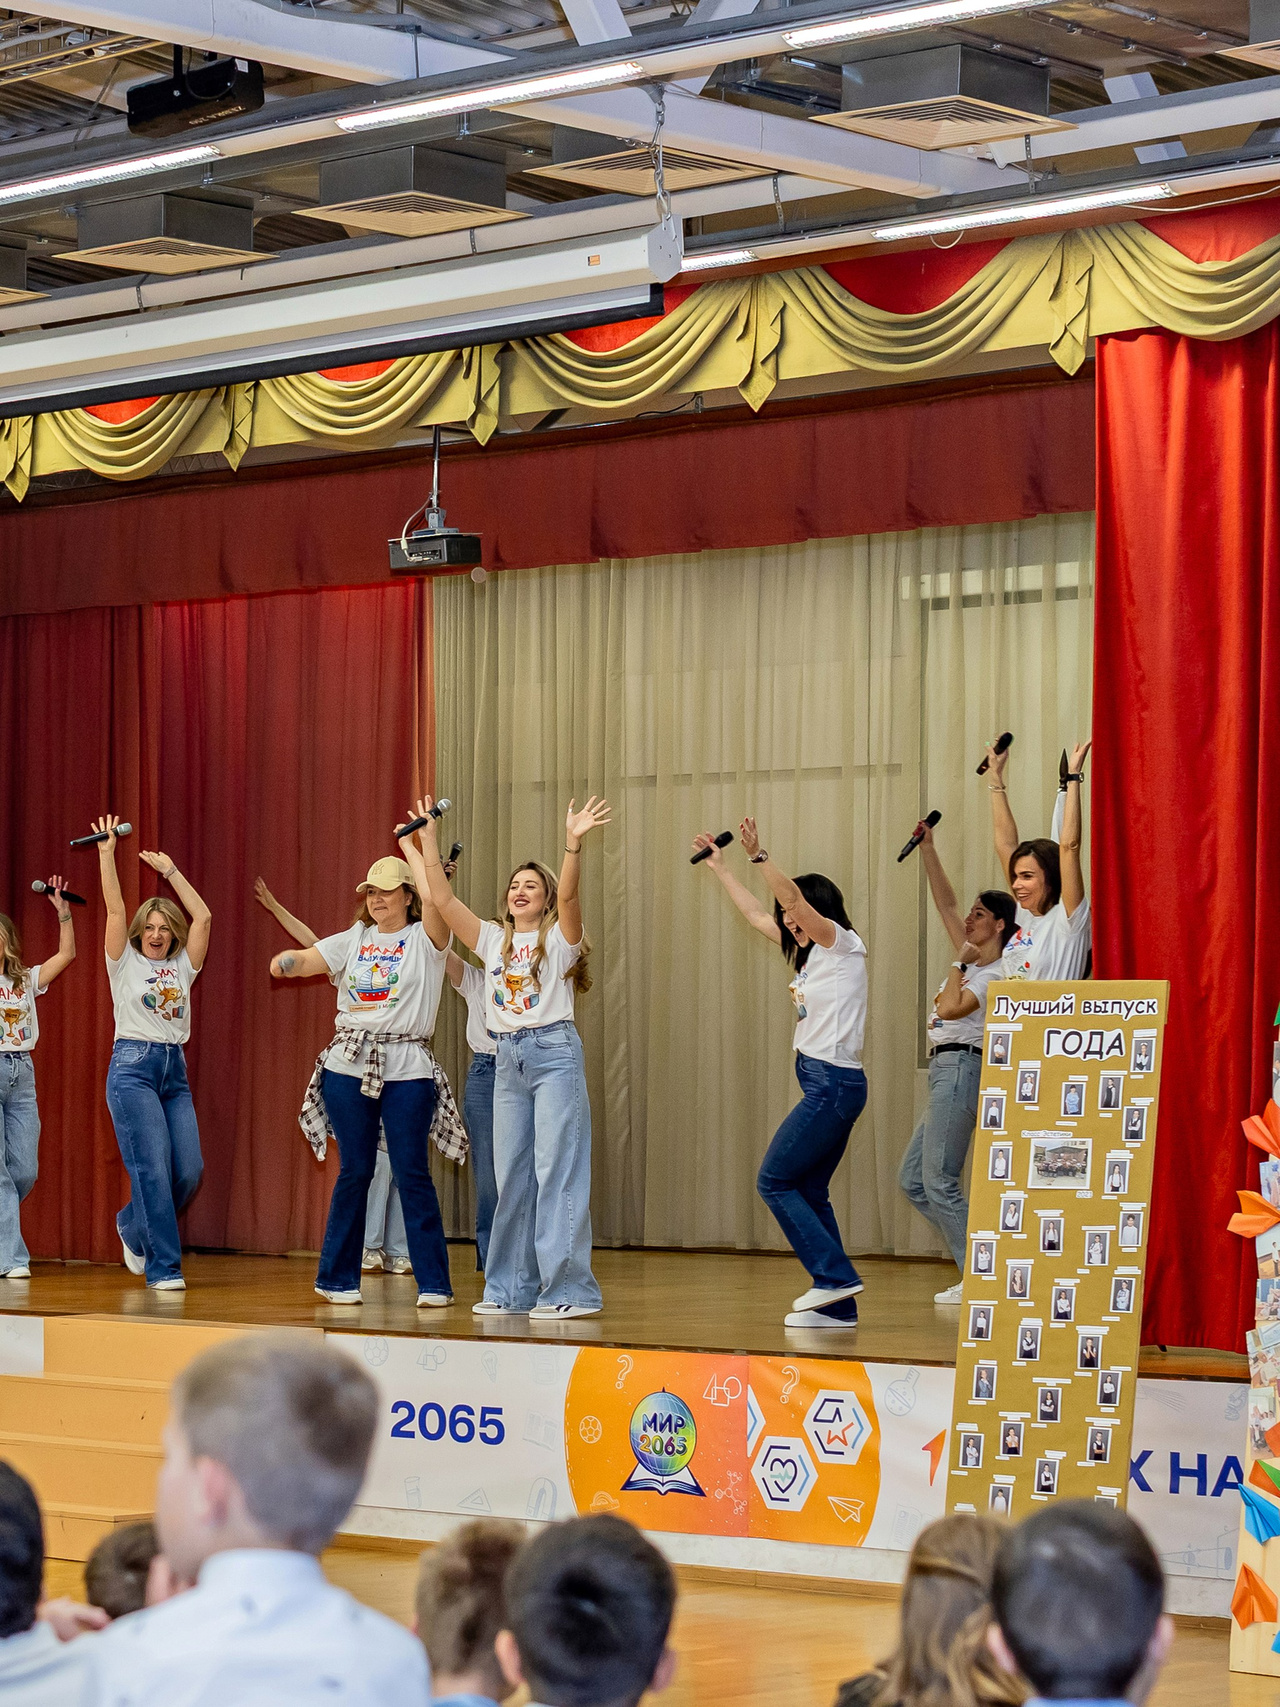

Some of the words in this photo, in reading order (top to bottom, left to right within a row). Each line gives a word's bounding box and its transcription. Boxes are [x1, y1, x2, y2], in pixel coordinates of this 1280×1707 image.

[994, 994, 1075, 1021] Лучший
[1082, 1000, 1157, 1020] выпуск
[1045, 1029, 1124, 1060] ГОДА
[389, 1400, 506, 1446] 2065
[641, 1412, 687, 1434] МИР
[639, 1433, 688, 1457] 2065
